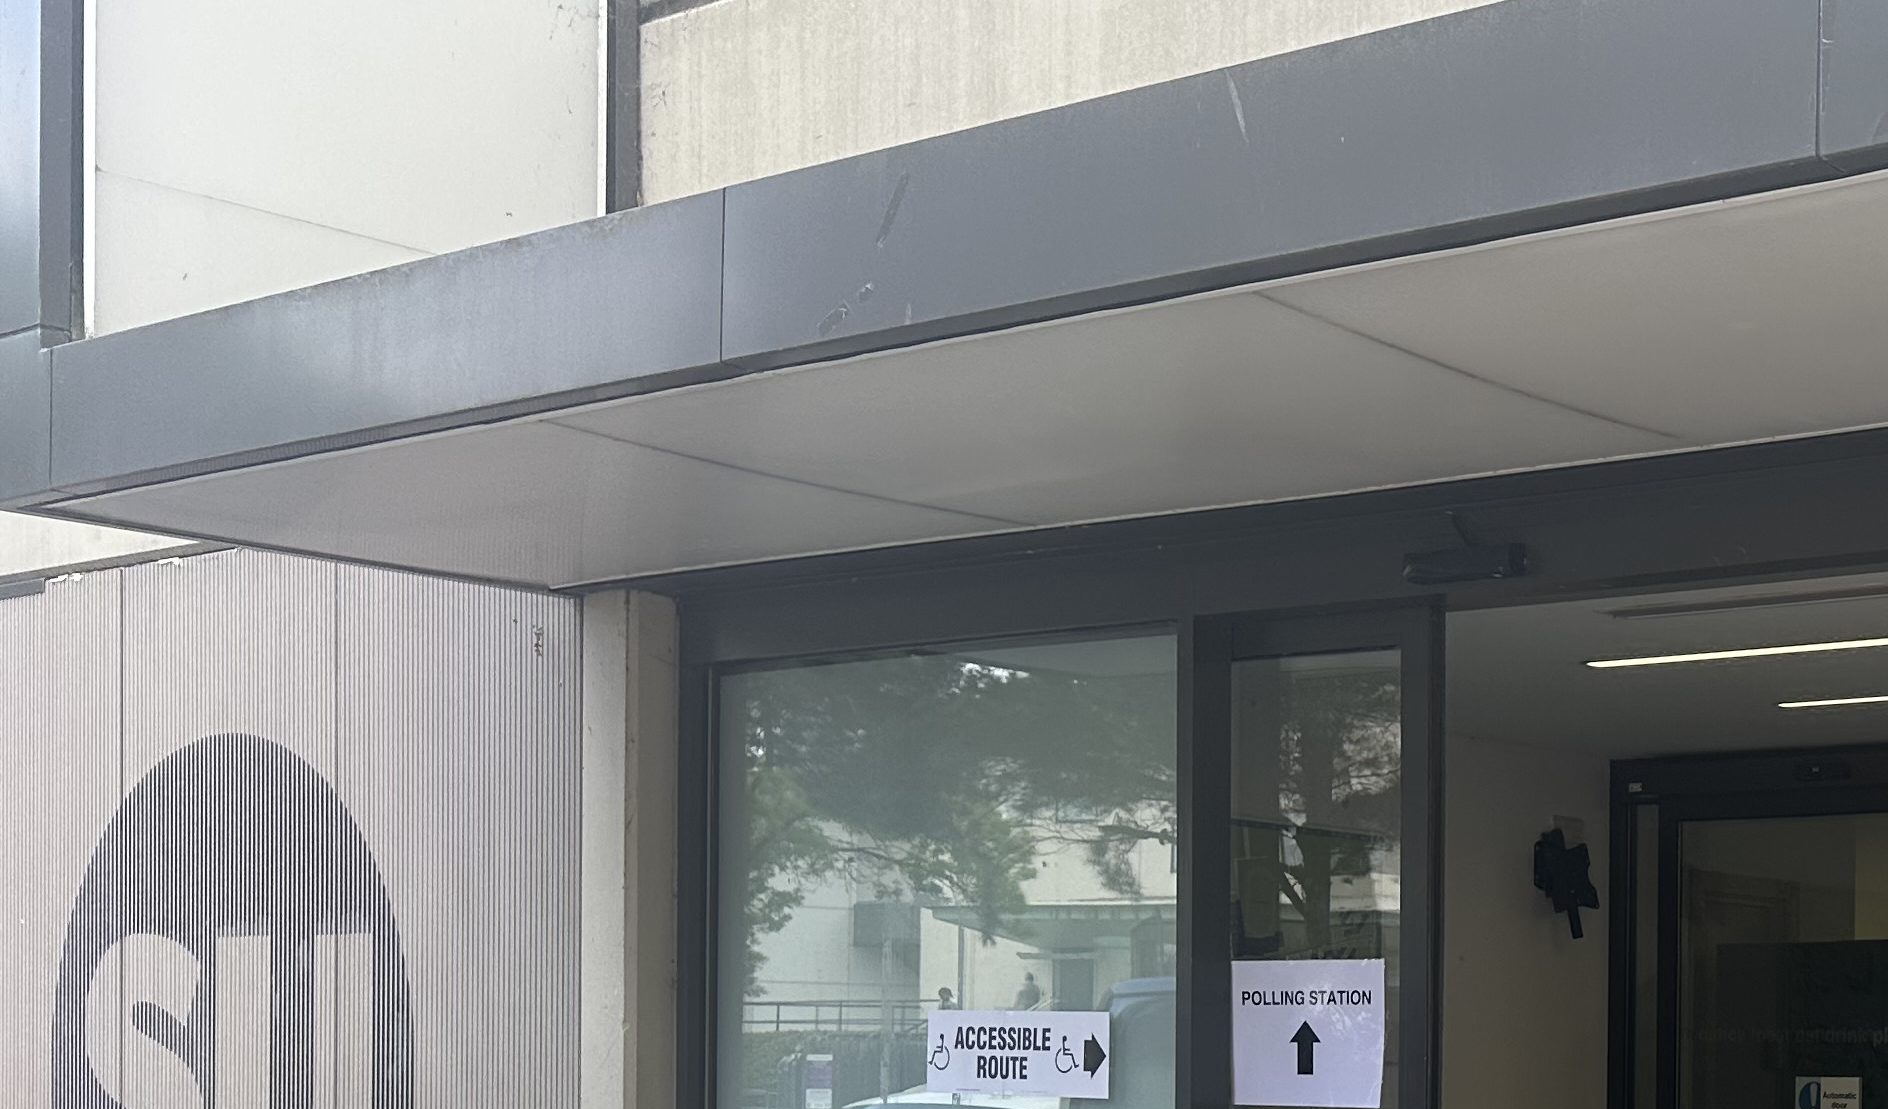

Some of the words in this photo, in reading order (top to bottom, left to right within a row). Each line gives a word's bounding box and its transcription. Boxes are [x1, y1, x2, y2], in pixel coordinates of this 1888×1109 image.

[1241, 989, 1305, 1006] POLLING
[1308, 988, 1372, 1006] STATION
[954, 1026, 1051, 1052] ACCESSIBLE
[977, 1055, 1028, 1081] ROUTE
[1822, 1091, 1857, 1100] Automatic
[1831, 1102, 1848, 1109] door
